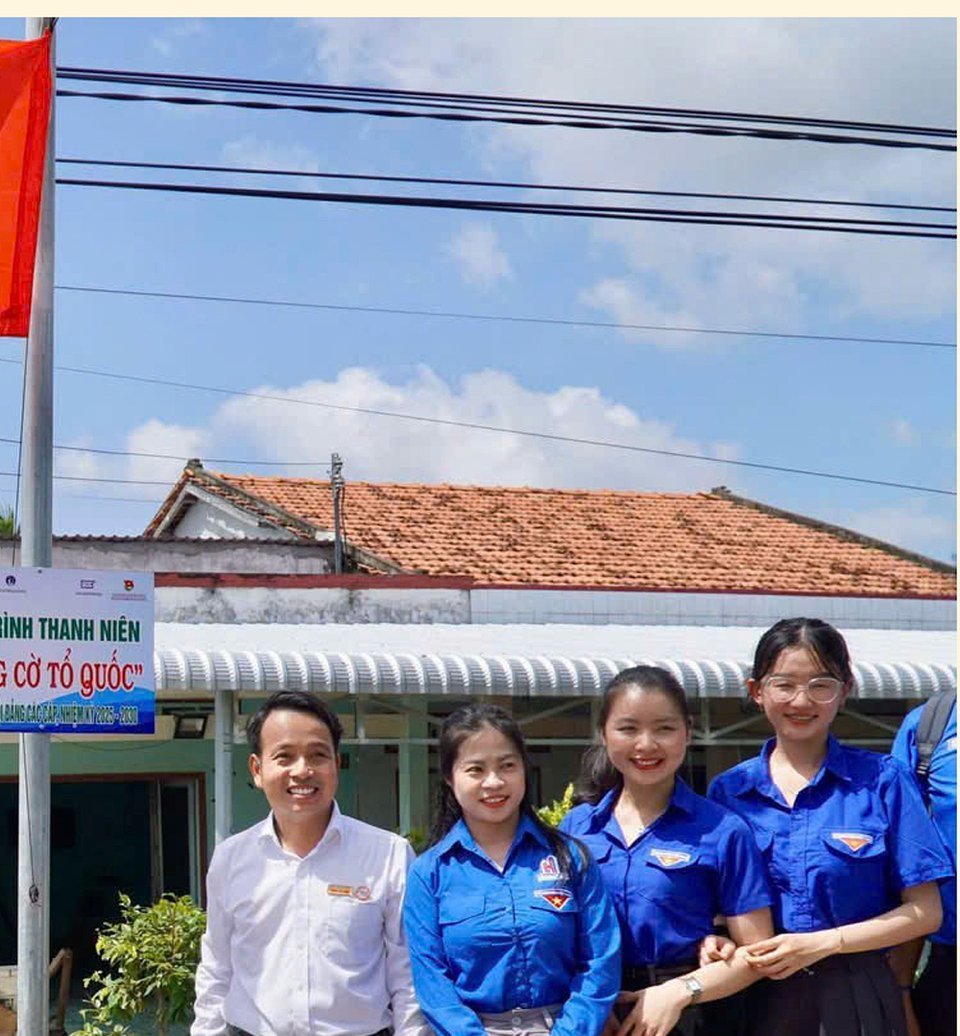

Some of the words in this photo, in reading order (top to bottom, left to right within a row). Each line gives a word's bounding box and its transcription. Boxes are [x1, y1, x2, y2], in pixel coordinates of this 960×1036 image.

[39, 617, 94, 642] THANH
[100, 616, 140, 642] NIÊN
[14, 653, 40, 688] CỜ
[47, 648, 74, 689] TỔ
